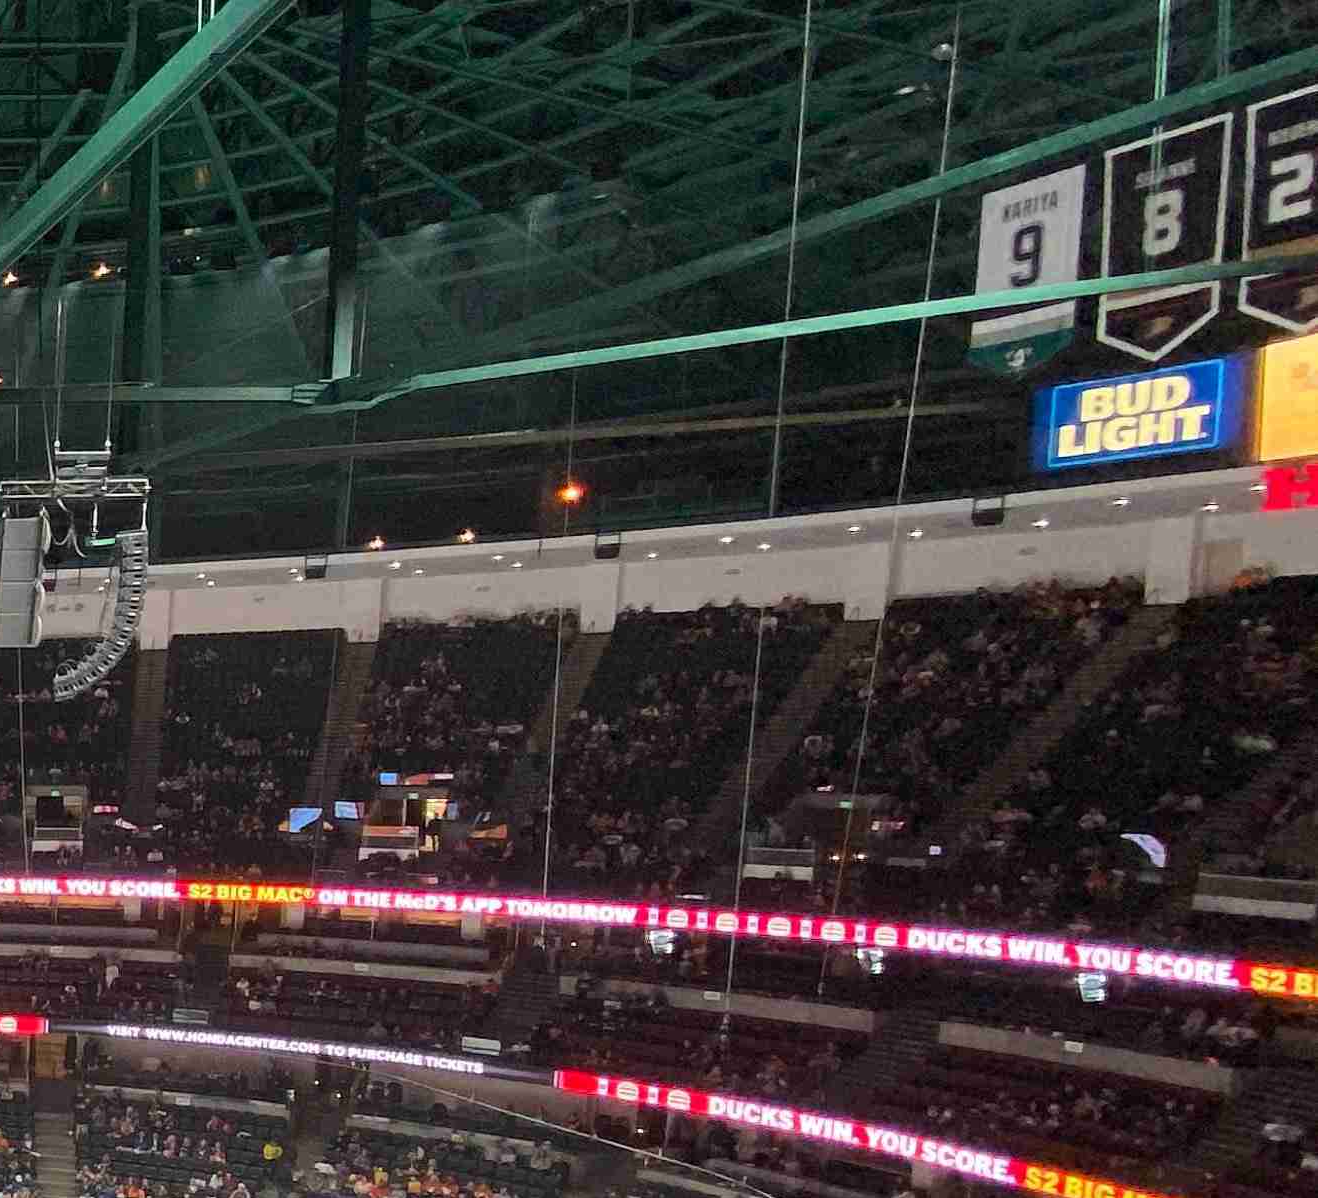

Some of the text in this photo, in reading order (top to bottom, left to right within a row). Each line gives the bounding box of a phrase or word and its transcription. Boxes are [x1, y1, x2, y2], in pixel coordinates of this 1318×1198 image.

[1000, 190, 1059, 222] KARIYA
[1142, 189, 1184, 256] 8
[1010, 223, 1043, 287] 9
[1080, 375, 1192, 423] BUD
[66, 879, 104, 896] YOU
[216, 883, 253, 900] BIG
[318, 888, 350, 906] ON
[354, 890, 393, 909] THE
[462, 897, 502, 916] APP
[507, 899, 639, 925] TOMORROW
[906, 926, 1004, 960] DUCKS
[1075, 941, 1132, 973] YOU
[325, 1041, 345, 1056] TO
[347, 1043, 424, 1066] PURCHASE
[425, 1052, 484, 1072] TICKETS
[707, 1095, 796, 1129] DUCKS
[865, 1125, 917, 1156] YOU
